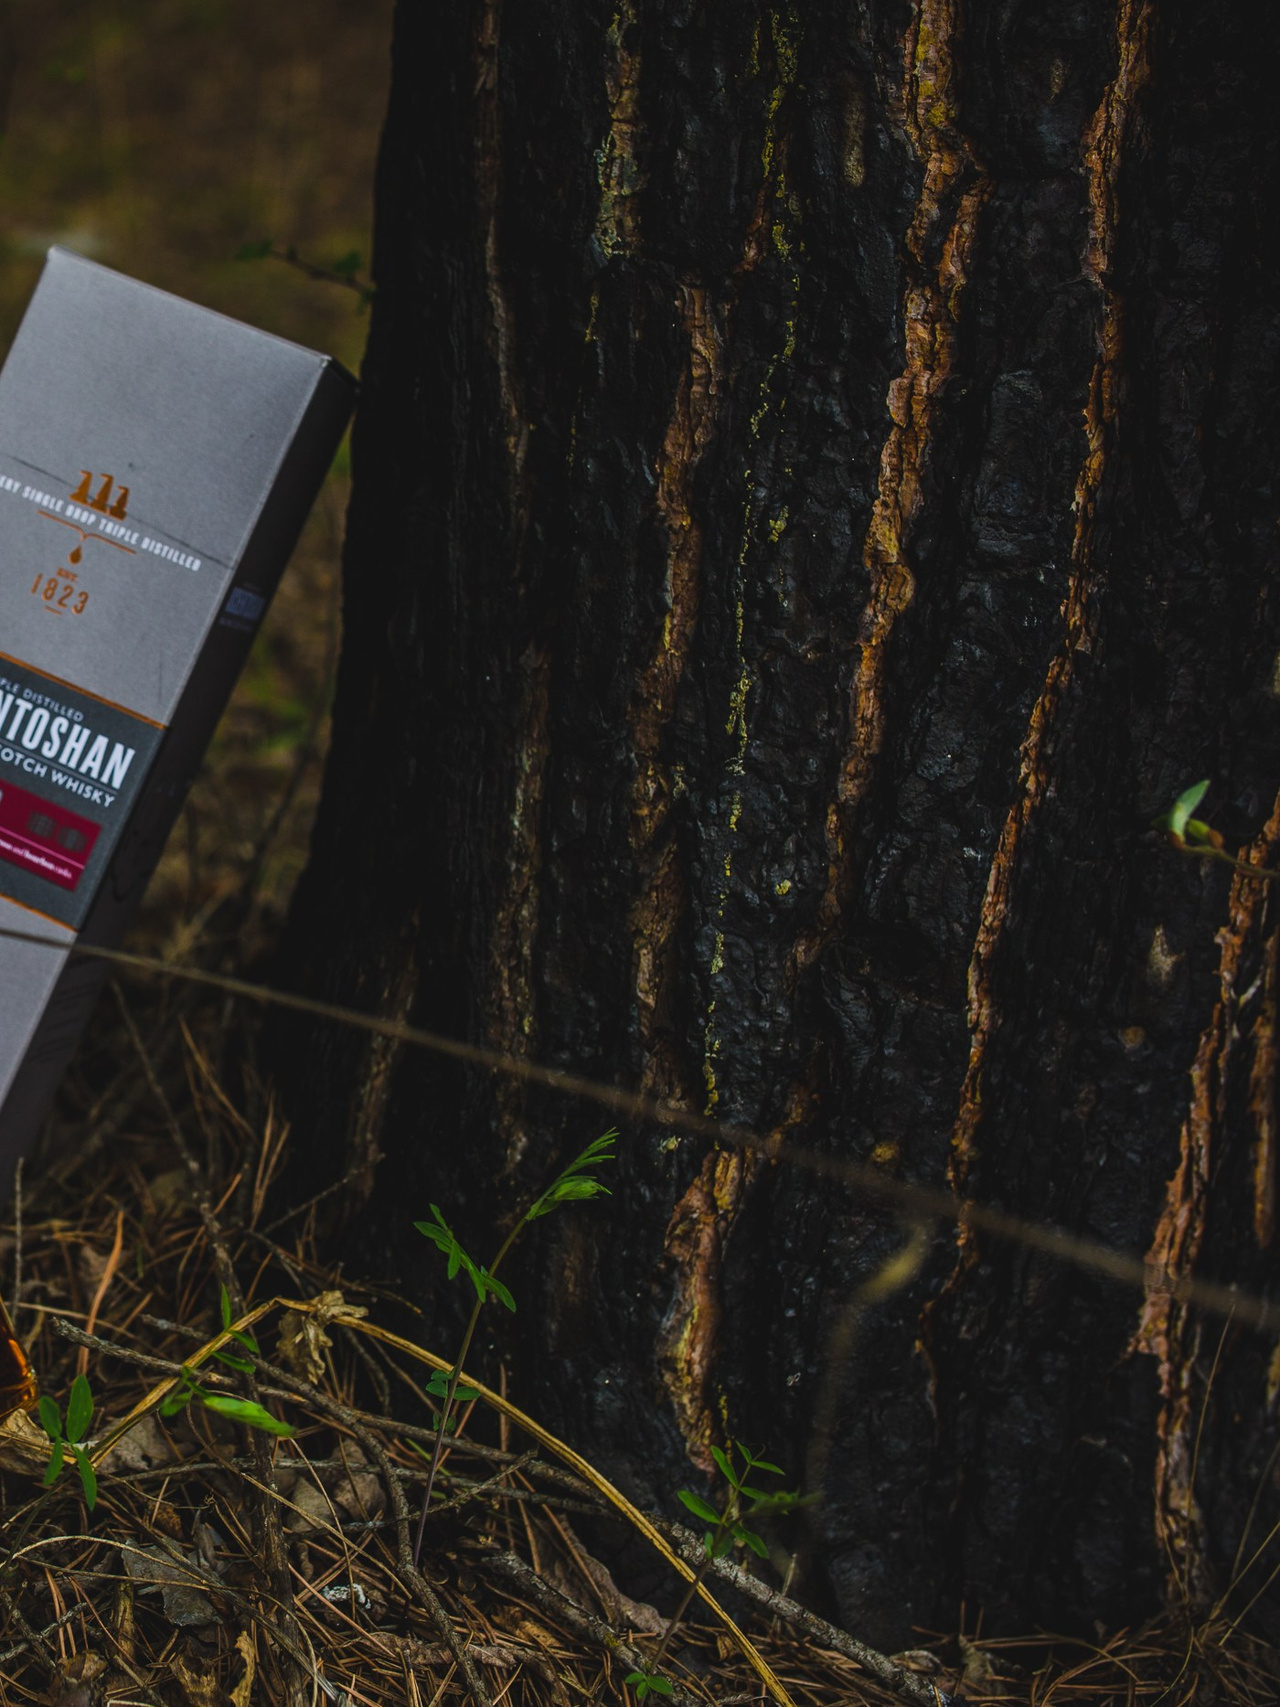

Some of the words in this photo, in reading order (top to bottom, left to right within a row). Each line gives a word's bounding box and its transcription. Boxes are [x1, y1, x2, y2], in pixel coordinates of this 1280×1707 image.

[22, 486, 64, 512] SINGLE
[65, 504, 96, 526] DROP
[98, 518, 140, 545] TRIPLE
[141, 537, 202, 572] DISTILLED
[30, 573, 89, 615] 1823
[23, 688, 84, 722] DISTILLED
[51, 770, 116, 808] WHISKY
